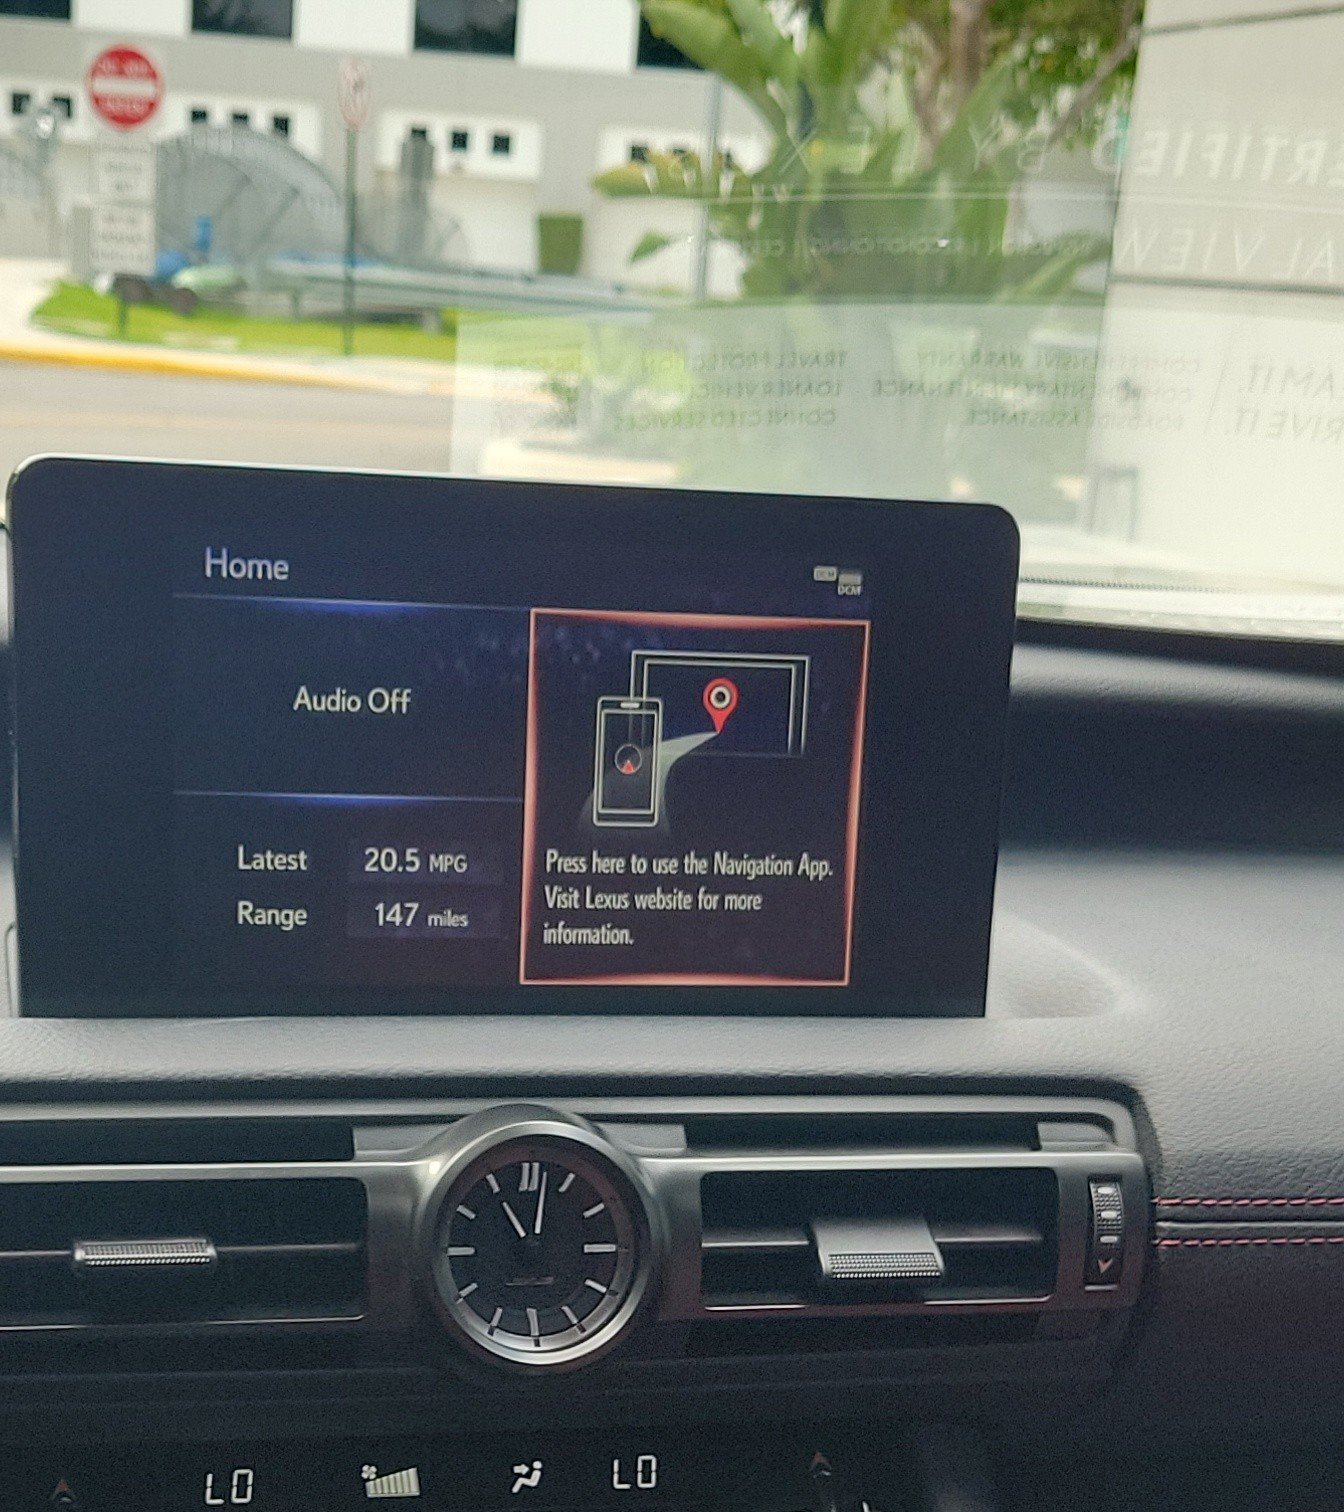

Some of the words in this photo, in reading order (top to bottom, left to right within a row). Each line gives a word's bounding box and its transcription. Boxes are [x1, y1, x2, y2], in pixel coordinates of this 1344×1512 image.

[204, 547, 289, 581] Home
[293, 684, 363, 715] Audio
[367, 684, 411, 714] Off
[237, 846, 308, 874] Latest
[364, 846, 420, 875] 20.5
[428, 853, 468, 875] MPG
[546, 849, 587, 876] Press
[591, 850, 627, 877] here
[630, 854, 648, 877] to
[652, 858, 678, 878] use
[683, 852, 709, 878] the
[713, 852, 792, 881] Navigation
[797, 853, 834, 883] App.
[544, 885, 580, 911] Visit
[585, 886, 629, 912] Lexus
[635, 887, 692, 912] website
[697, 888, 720, 913] for
[724, 893, 763, 914] more
[237, 901, 308, 931] Range
[373, 901, 419, 928] 147
[427, 907, 469, 929] miles
[543, 922, 635, 947] information.
[206, 1468, 253, 1505] LO
[613, 1454, 659, 1490] LO
